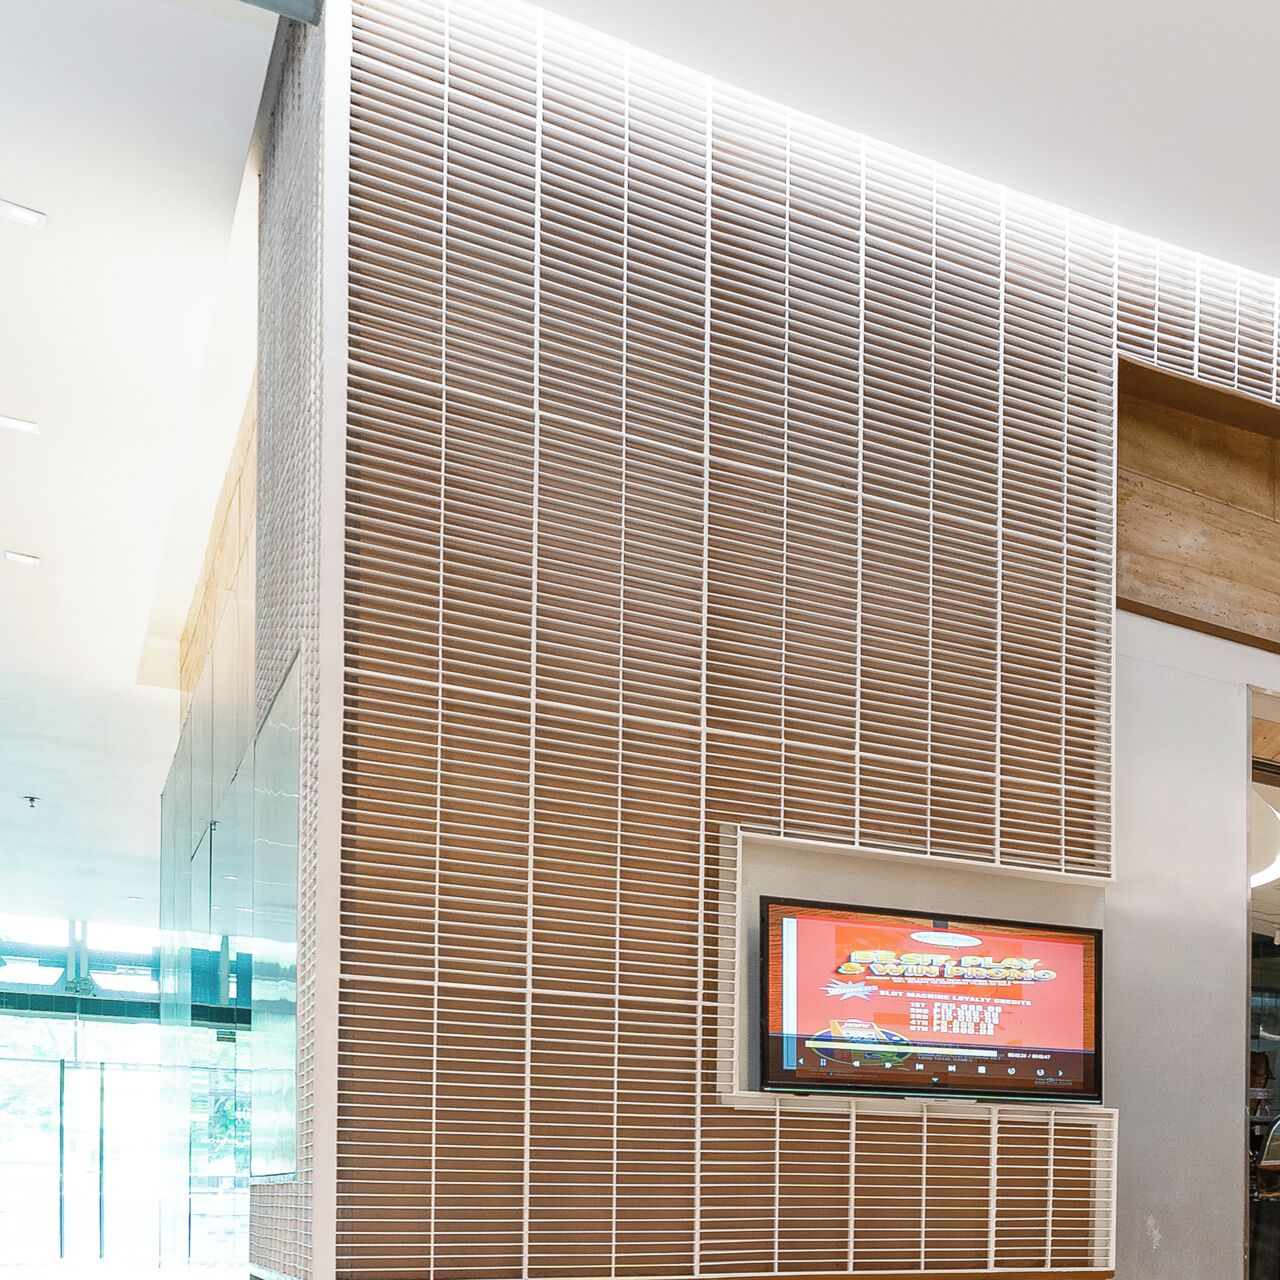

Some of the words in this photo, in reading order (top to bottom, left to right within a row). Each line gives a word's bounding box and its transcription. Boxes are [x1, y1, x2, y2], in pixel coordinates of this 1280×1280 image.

[868, 963, 940, 977] WIN
[943, 965, 1057, 981] PROMO
[906, 991, 951, 1000] MACHINE
[952, 994, 992, 1004] LOYALTY
[993, 998, 1032, 1006] CREDITS
